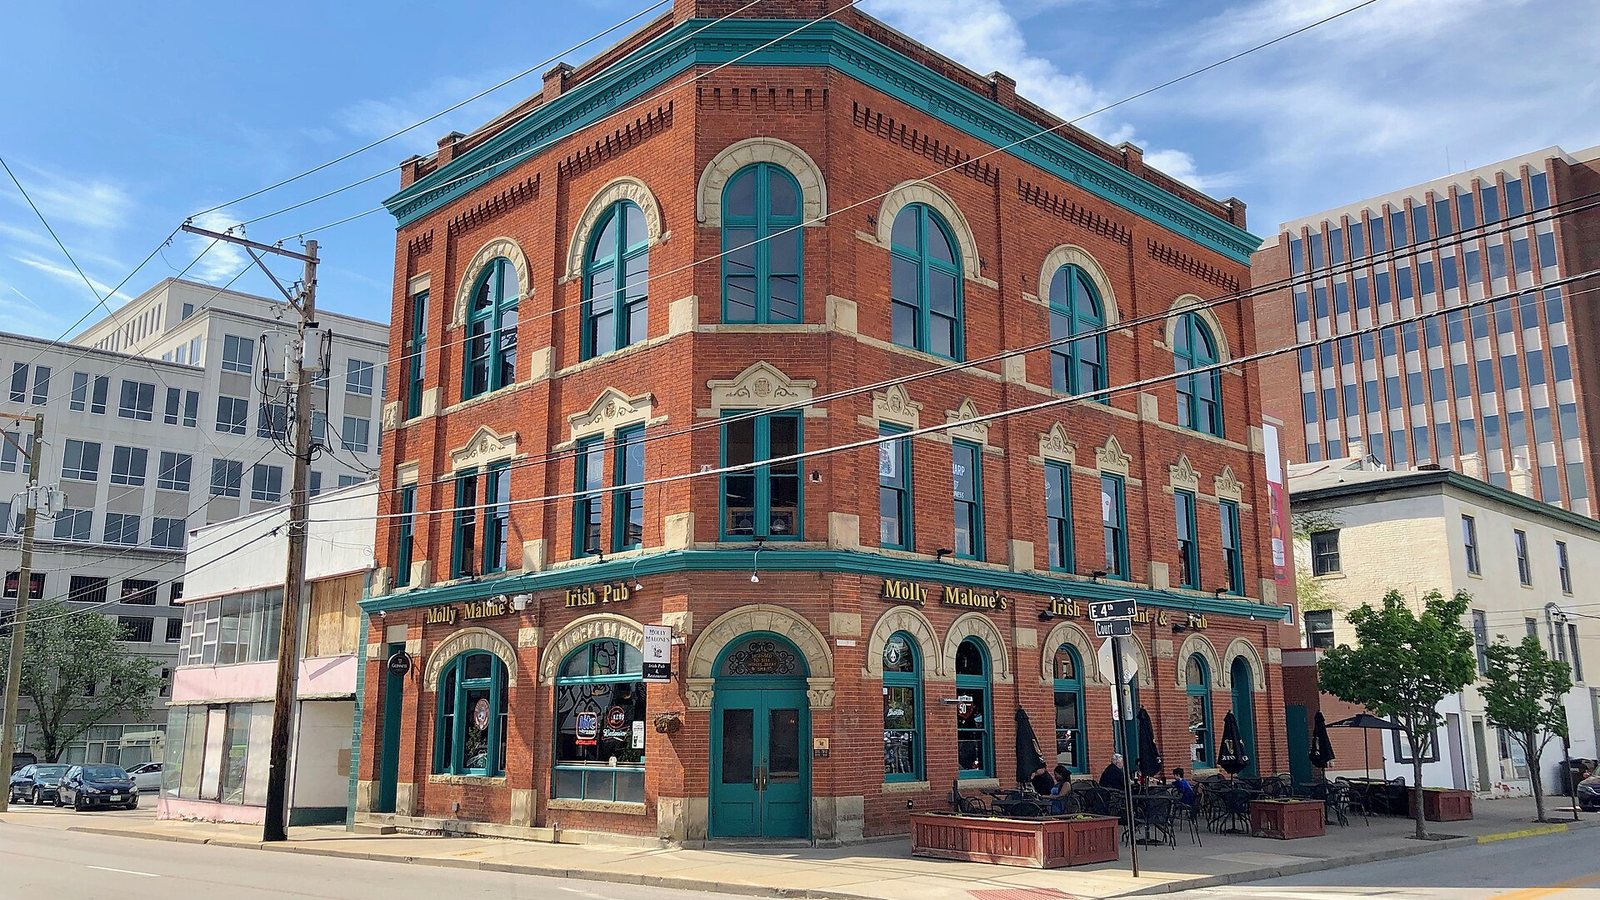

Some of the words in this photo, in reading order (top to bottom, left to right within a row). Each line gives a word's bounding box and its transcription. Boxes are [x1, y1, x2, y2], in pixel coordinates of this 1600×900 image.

[565, 587, 596, 608] Irish
[602, 582, 630, 603] Pub
[885, 580, 928, 606] Molly
[945, 586, 1007, 610] Malone's
[427, 606, 456, 625] Molly
[1052, 600, 1081, 617] Irish
[1159, 610, 1168, 626] &
[1091, 605, 1098, 618] E
[1100, 604, 1114, 617] 4th
[1097, 622, 1114, 635] Court
[1124, 626, 1130, 634] St
